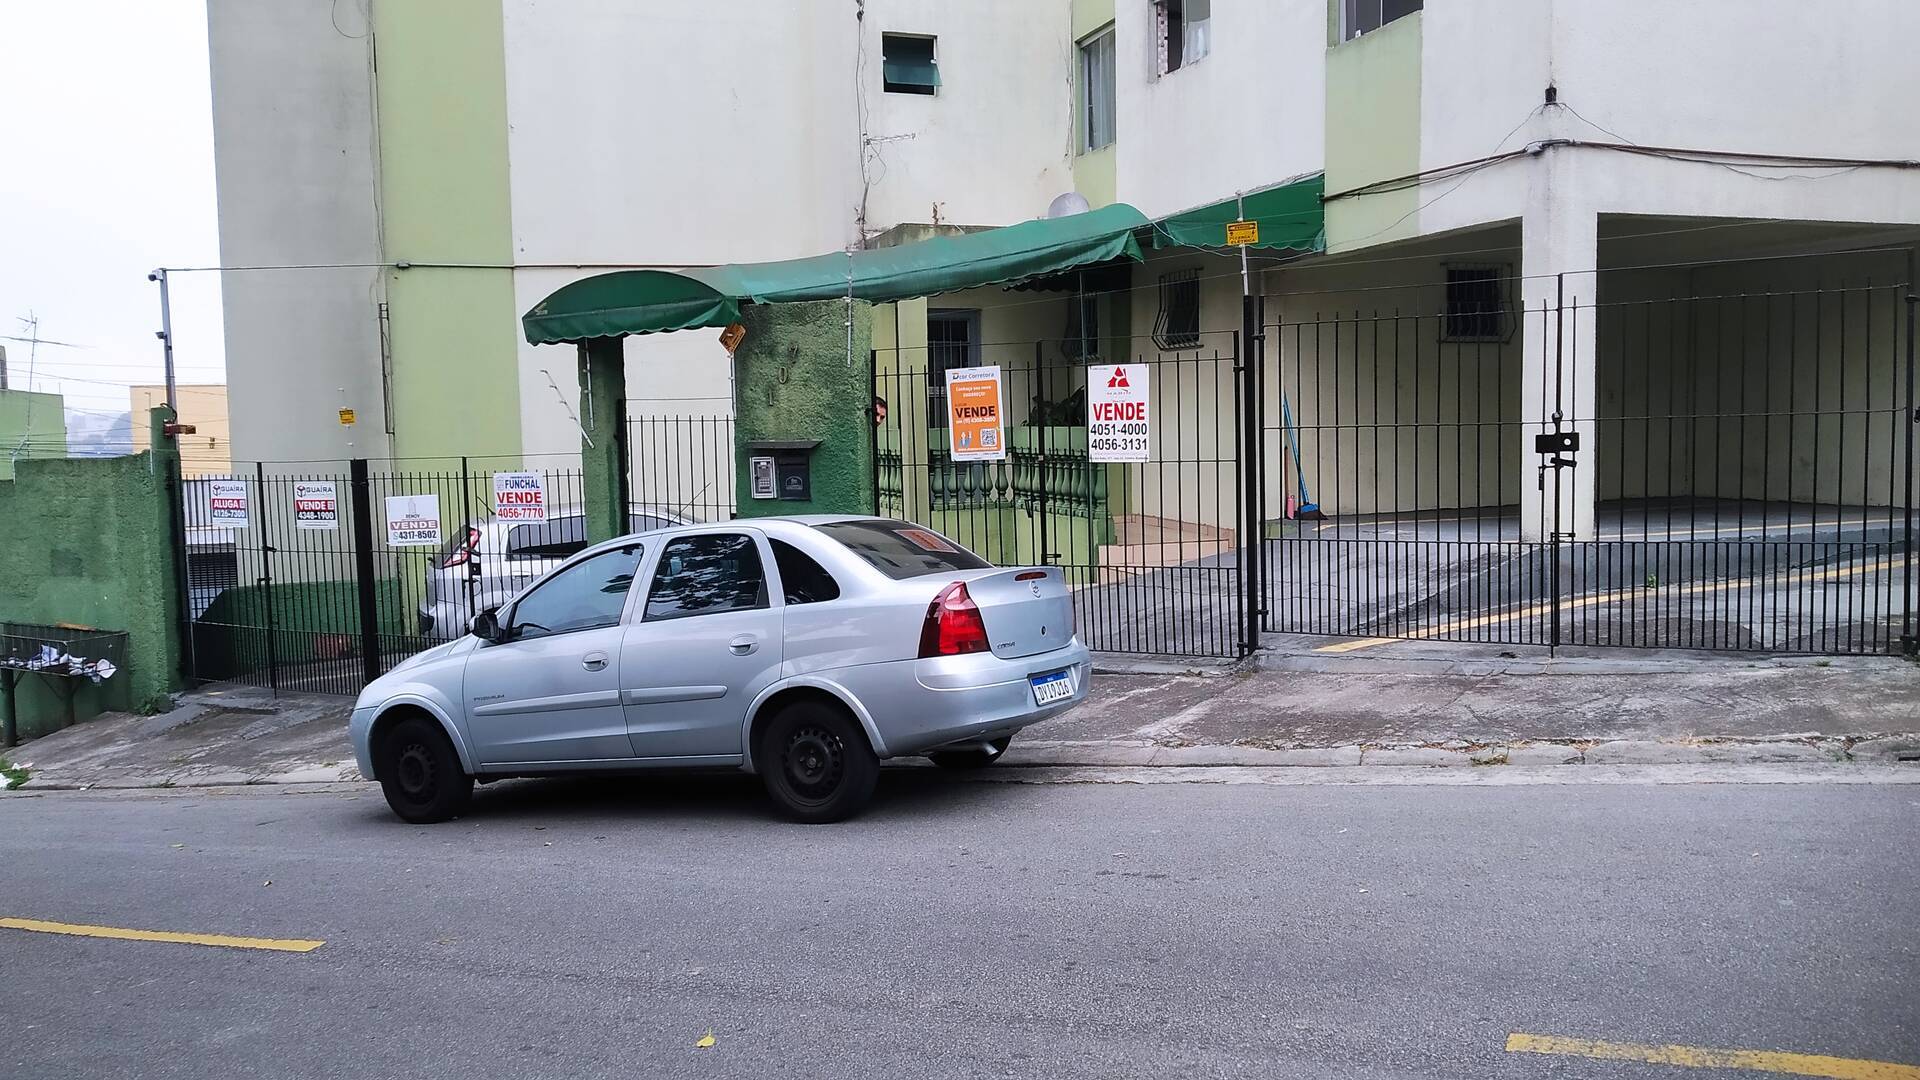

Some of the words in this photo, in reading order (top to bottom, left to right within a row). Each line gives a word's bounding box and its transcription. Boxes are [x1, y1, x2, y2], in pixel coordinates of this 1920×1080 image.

[955, 405, 996, 418] VENDE
[1093, 402, 1145, 421] VENDE
[1090, 423, 1148, 435] 4051-4000
[1091, 438, 1148, 451] 4056-3131
[504, 480, 540, 489] FUNCHAL
[496, 491, 542, 504] VENDE
[213, 499, 239, 509] ALUGA
[297, 501, 326, 510] VENDE
[298, 511, 335, 520] 4348-1900
[497, 508, 544, 519] 4056-7770
[391, 521, 437, 530] VENDE
[399, 530, 437, 540] 4317-8502
